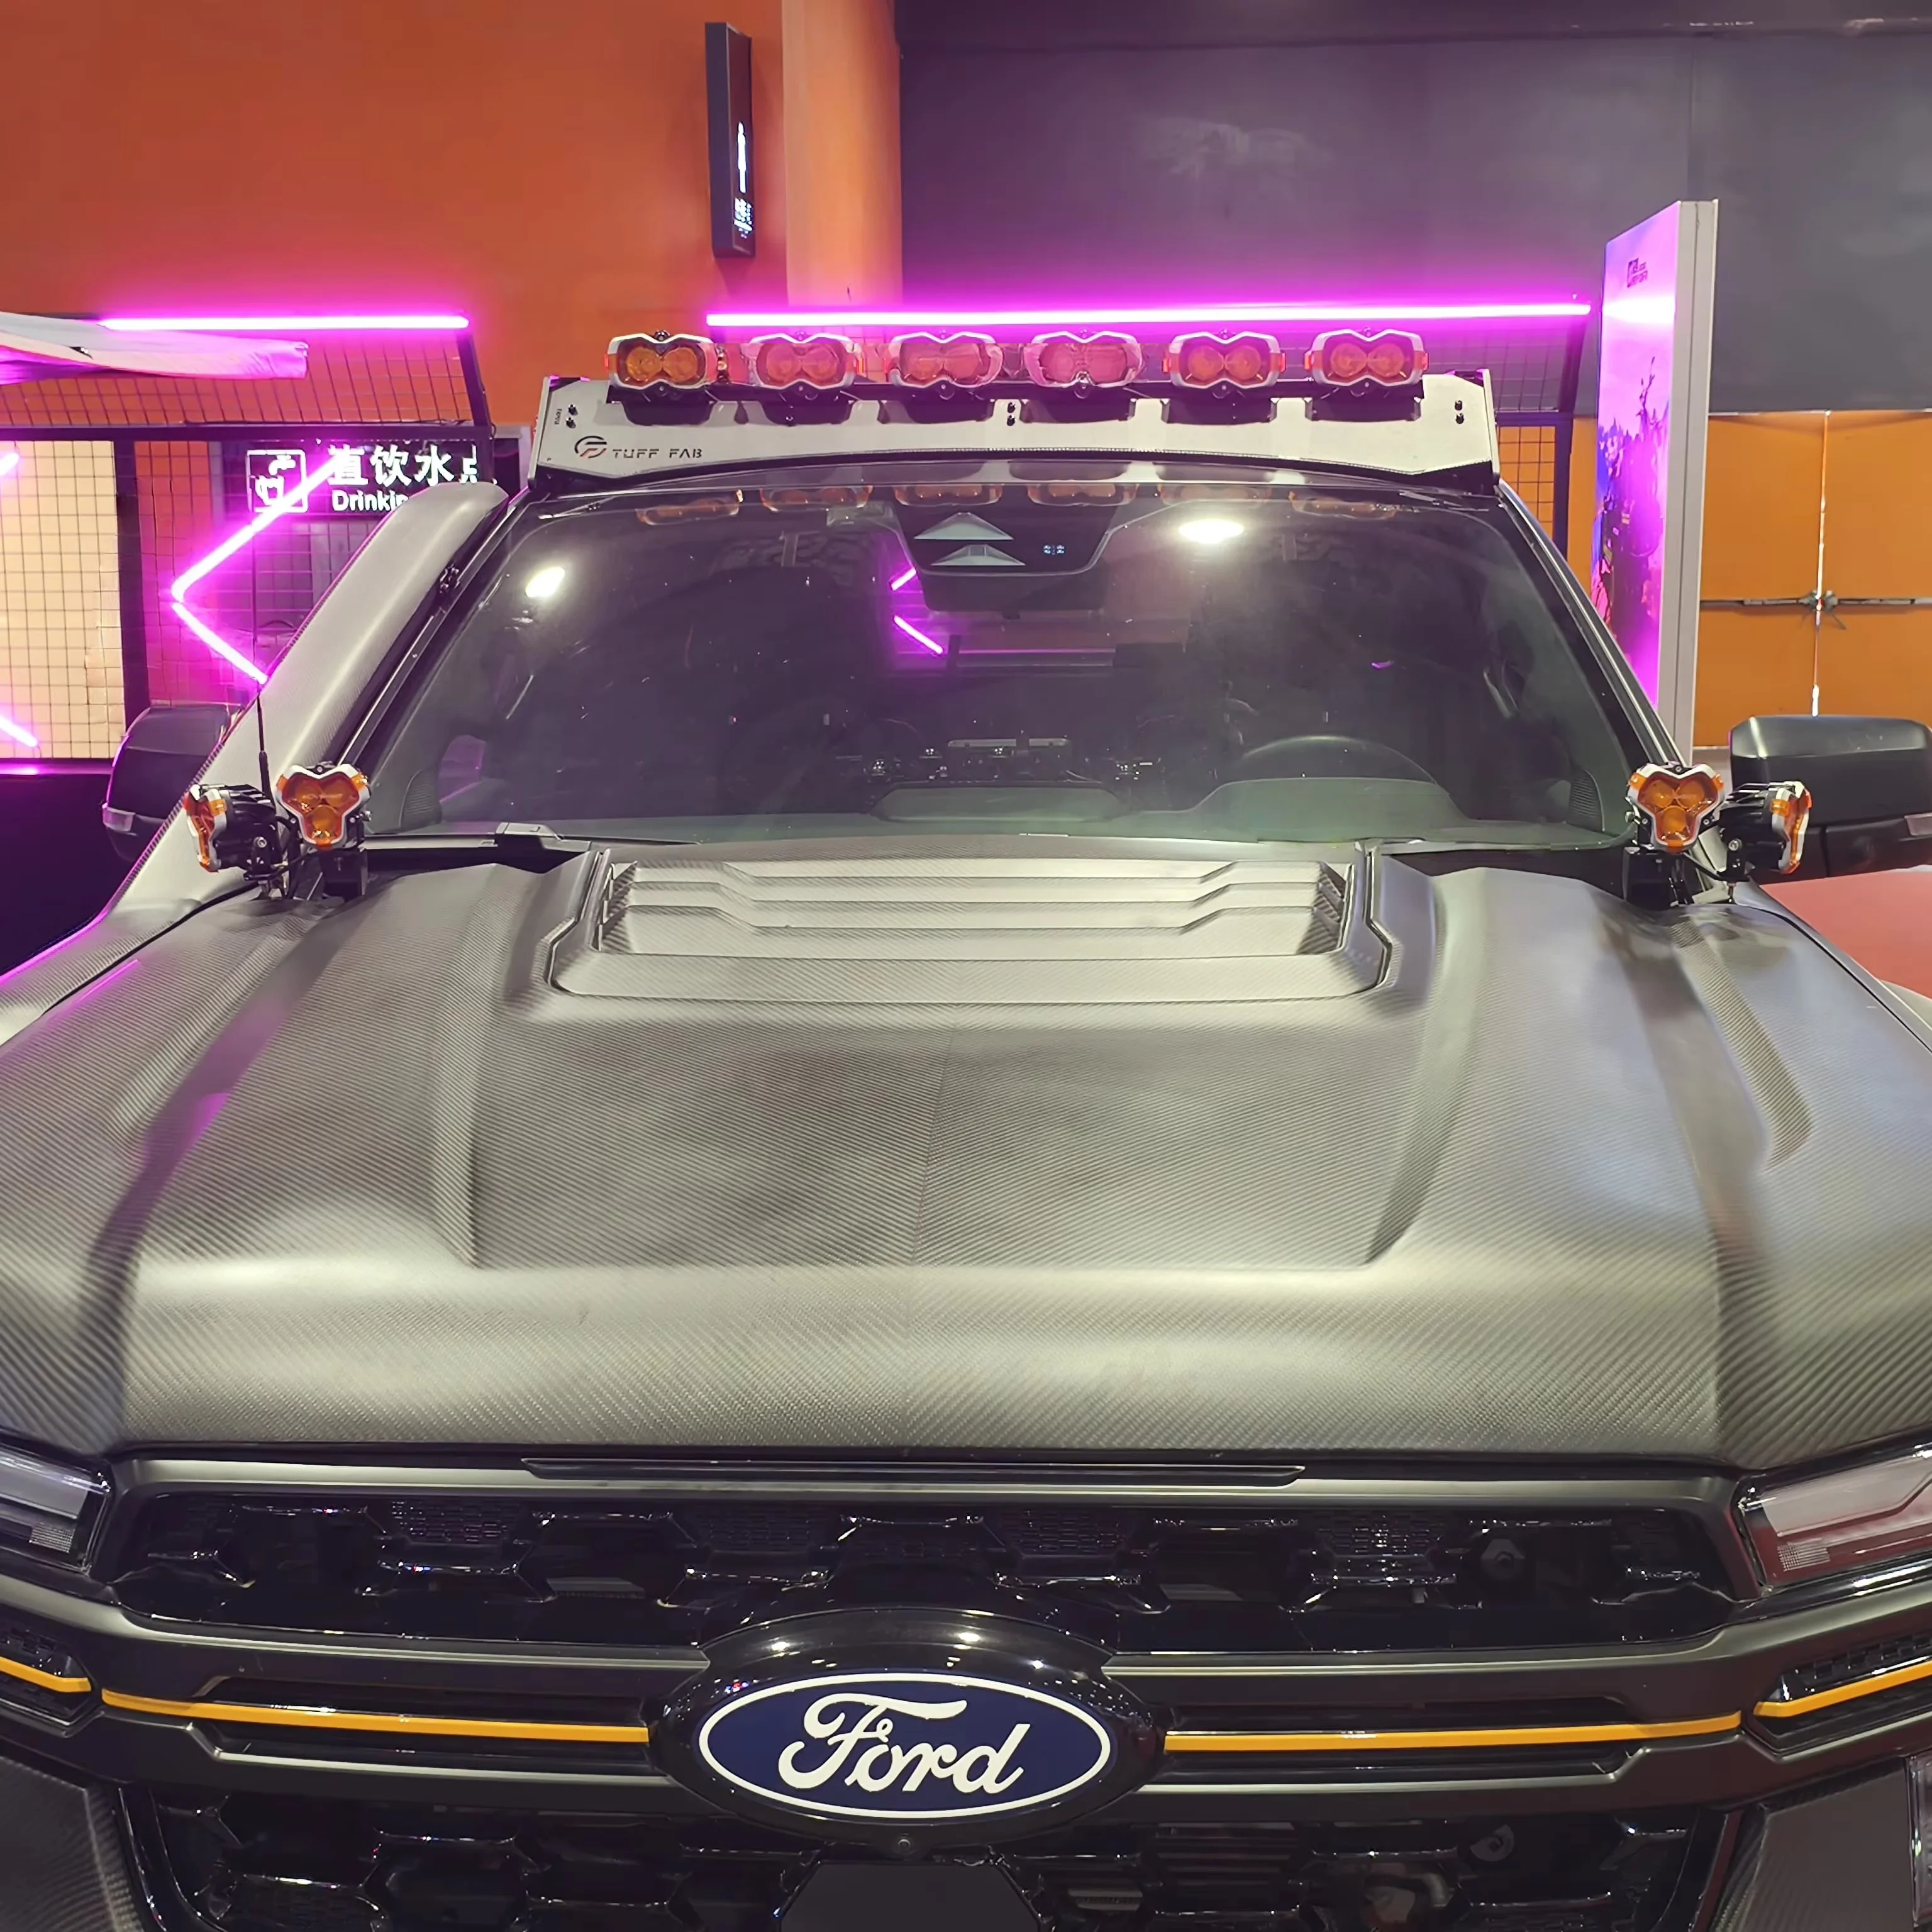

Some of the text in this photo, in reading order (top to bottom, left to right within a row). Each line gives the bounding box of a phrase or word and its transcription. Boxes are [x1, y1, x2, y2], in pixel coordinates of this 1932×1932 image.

[612, 448, 702, 458] TUFF FAB
[778, 1692, 1031, 1794] Ford
